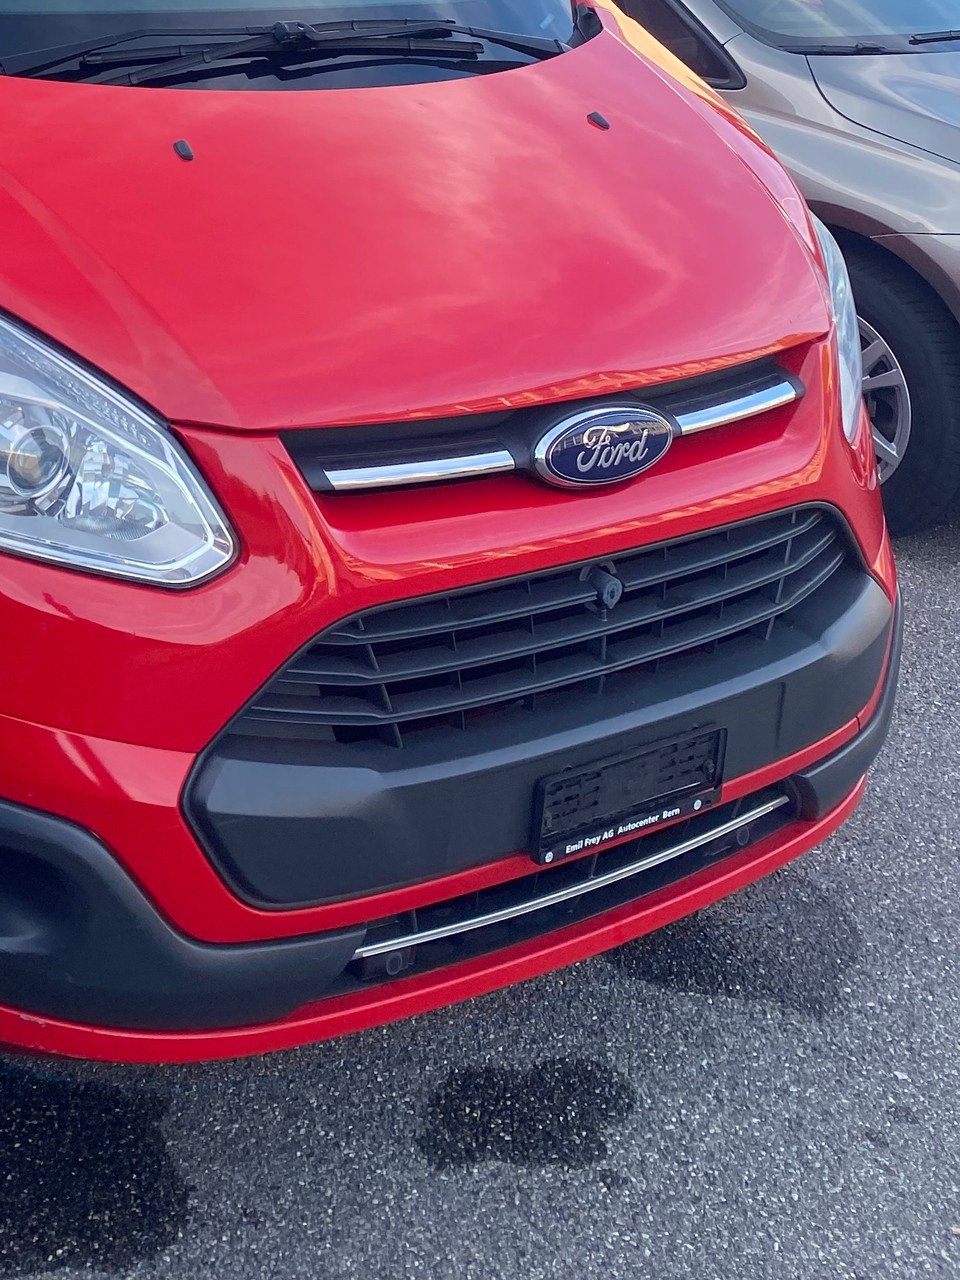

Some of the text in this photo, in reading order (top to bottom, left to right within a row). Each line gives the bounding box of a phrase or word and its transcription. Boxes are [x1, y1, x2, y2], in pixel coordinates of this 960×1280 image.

[576, 422, 649, 473] Ford
[565, 808, 680, 854] Emil Frey AG Autocenter Bern
